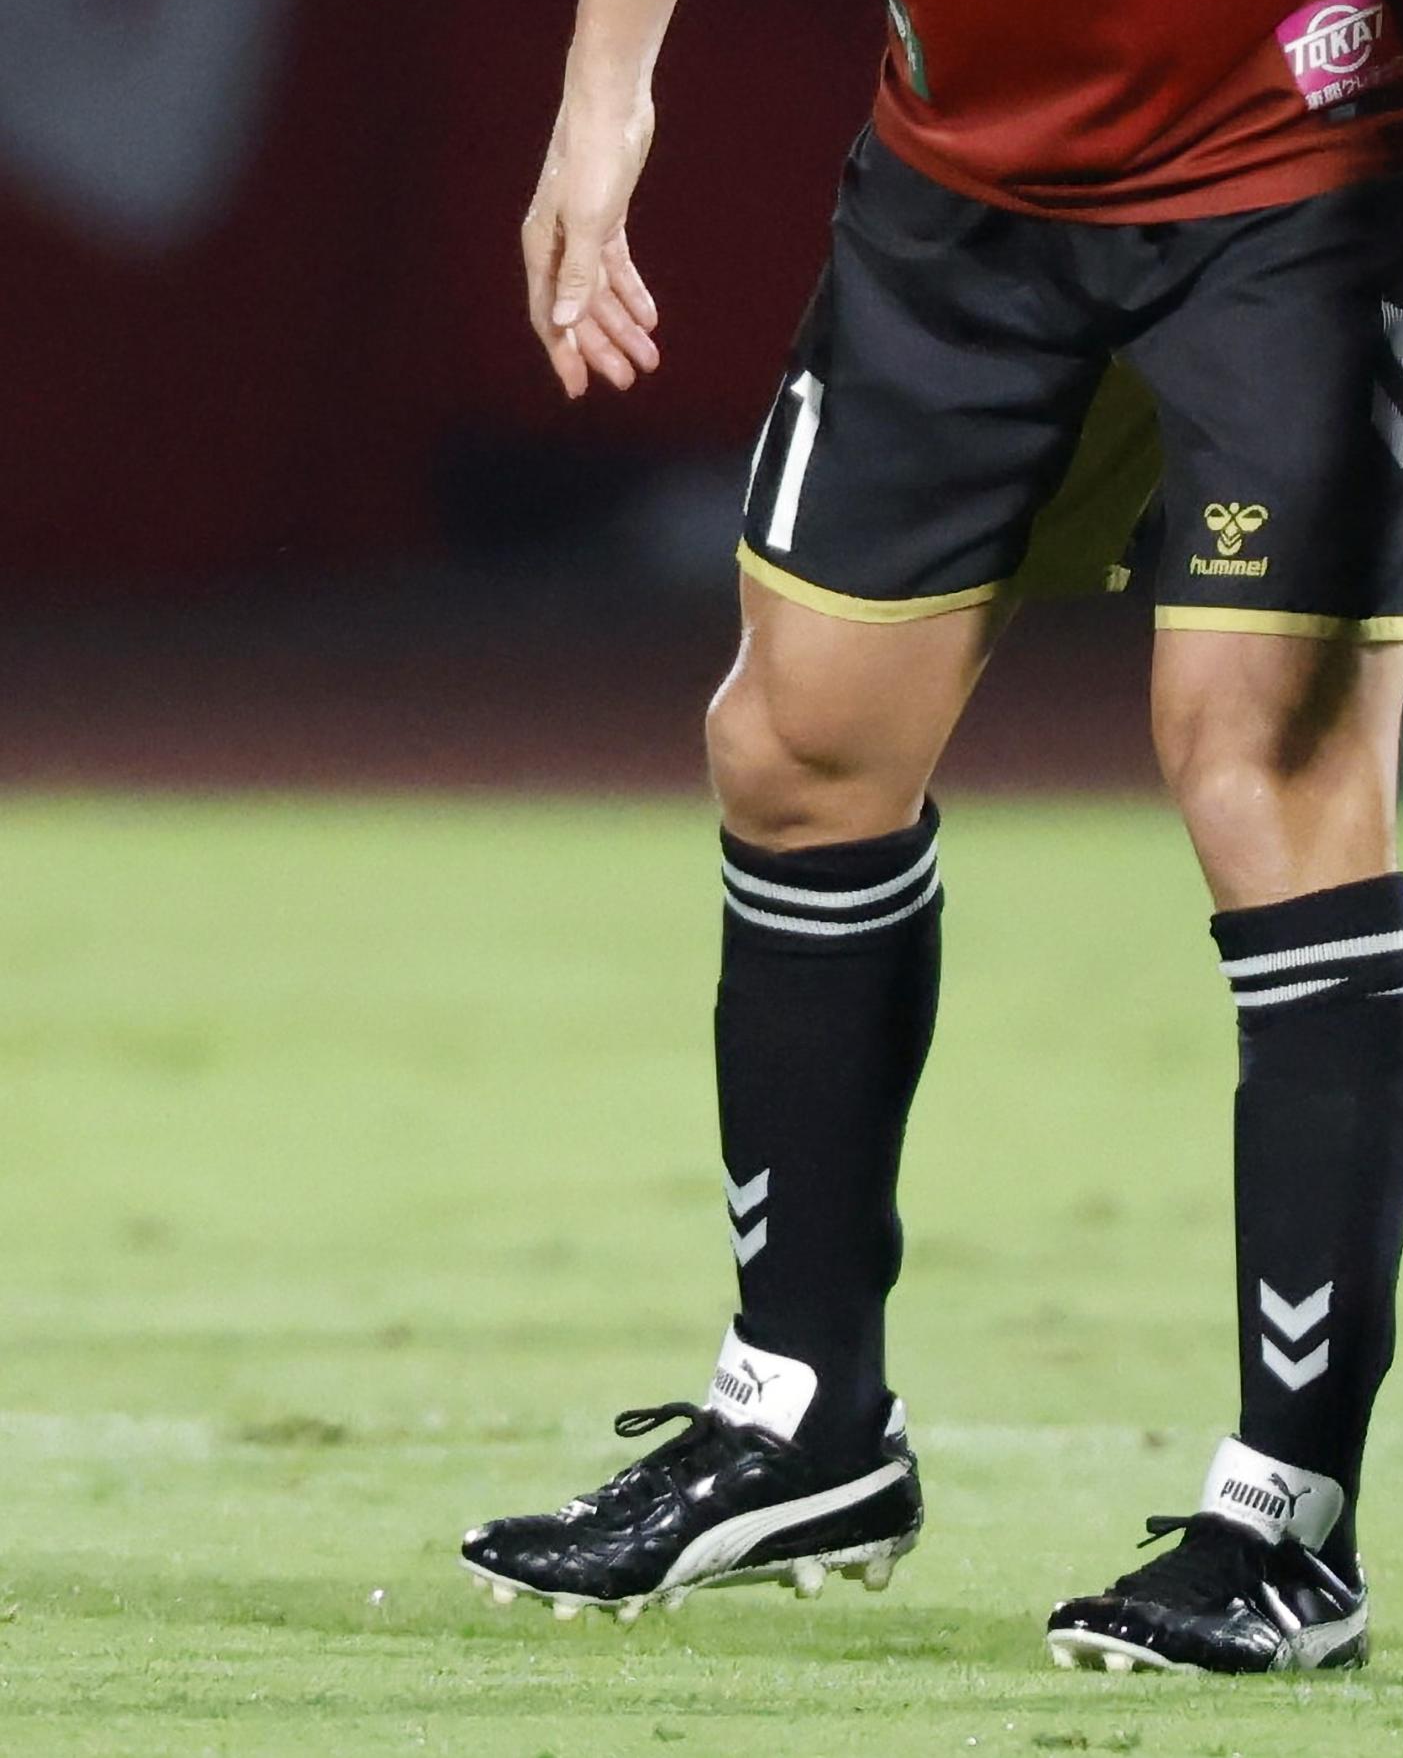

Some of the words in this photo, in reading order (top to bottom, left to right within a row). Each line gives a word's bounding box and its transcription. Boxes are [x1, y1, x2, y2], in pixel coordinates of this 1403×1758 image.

[1284, 4, 1383, 77] TOKAI
[1190, 554, 1269, 577] hummel
[1220, 1478, 1286, 1519] PUMA
